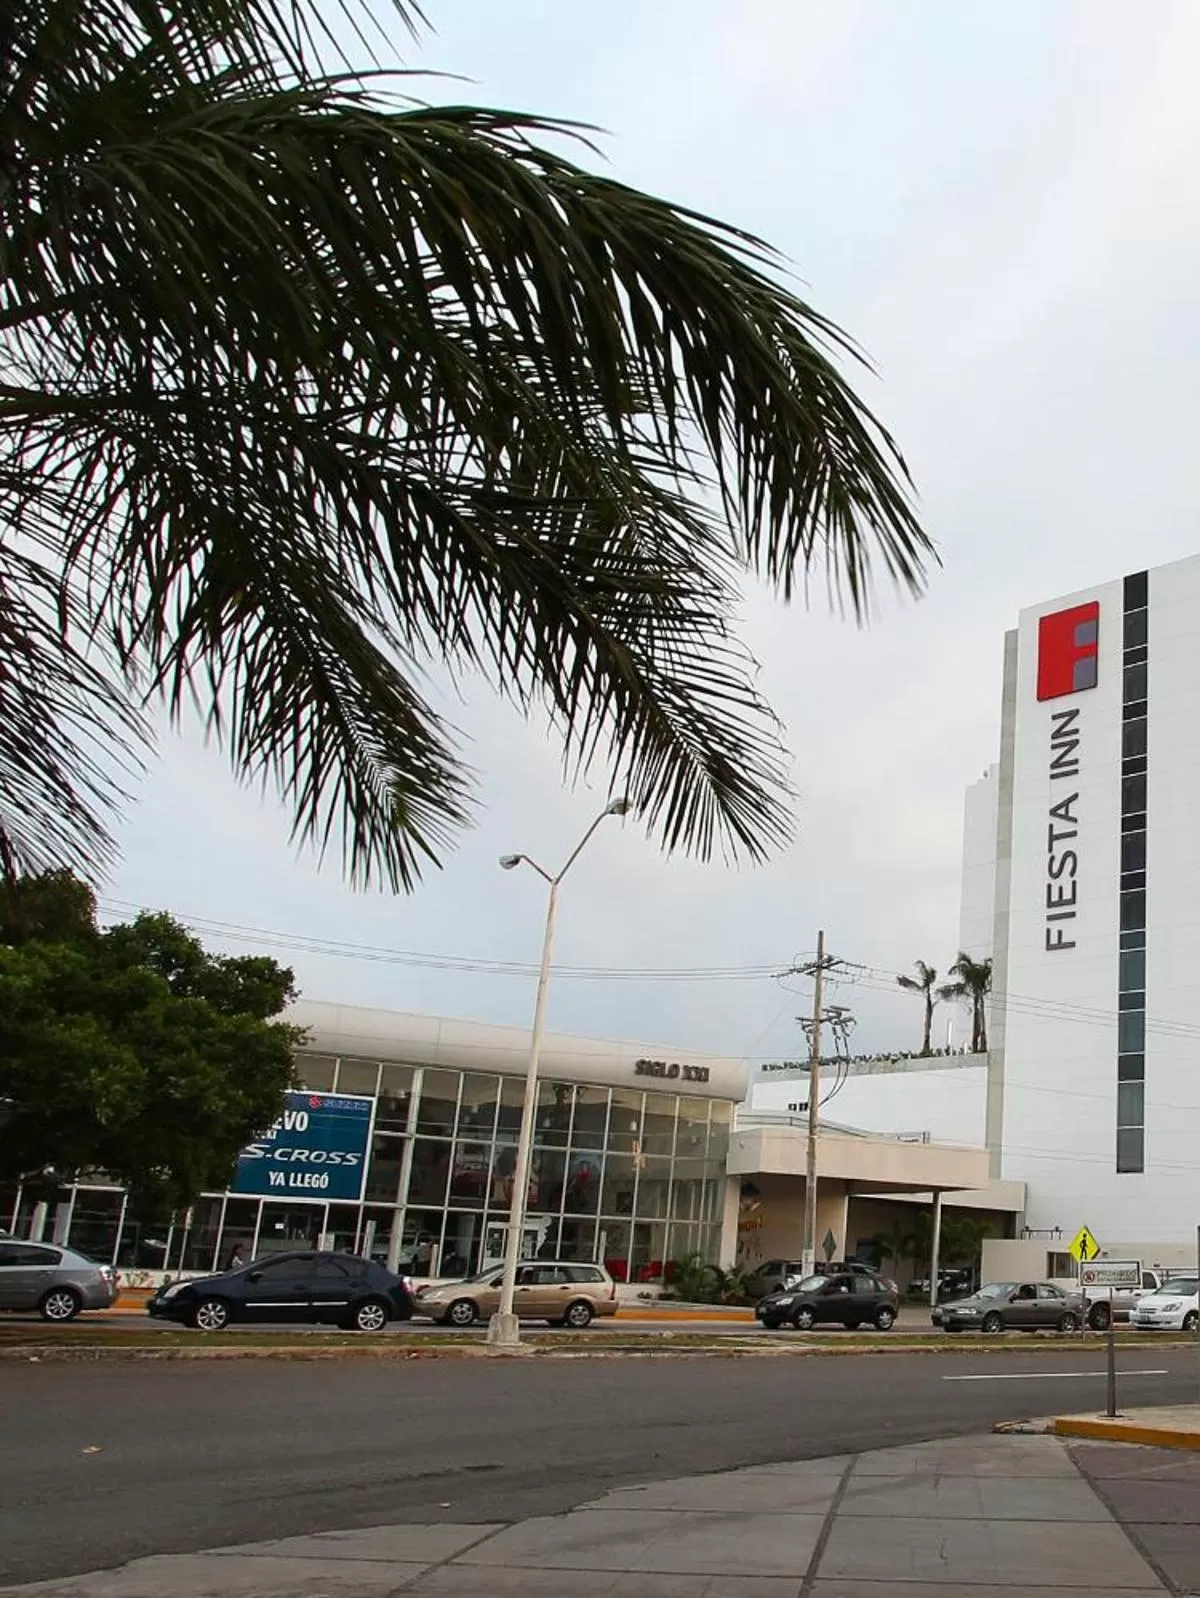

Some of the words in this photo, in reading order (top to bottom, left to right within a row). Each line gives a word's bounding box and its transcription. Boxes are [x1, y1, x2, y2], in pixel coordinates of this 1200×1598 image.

[1049, 708, 1080, 780] INN
[1046, 792, 1079, 951] FIESTA
[268, 1171, 286, 1186] YA
[288, 1172, 330, 1189] LLEGÓ
